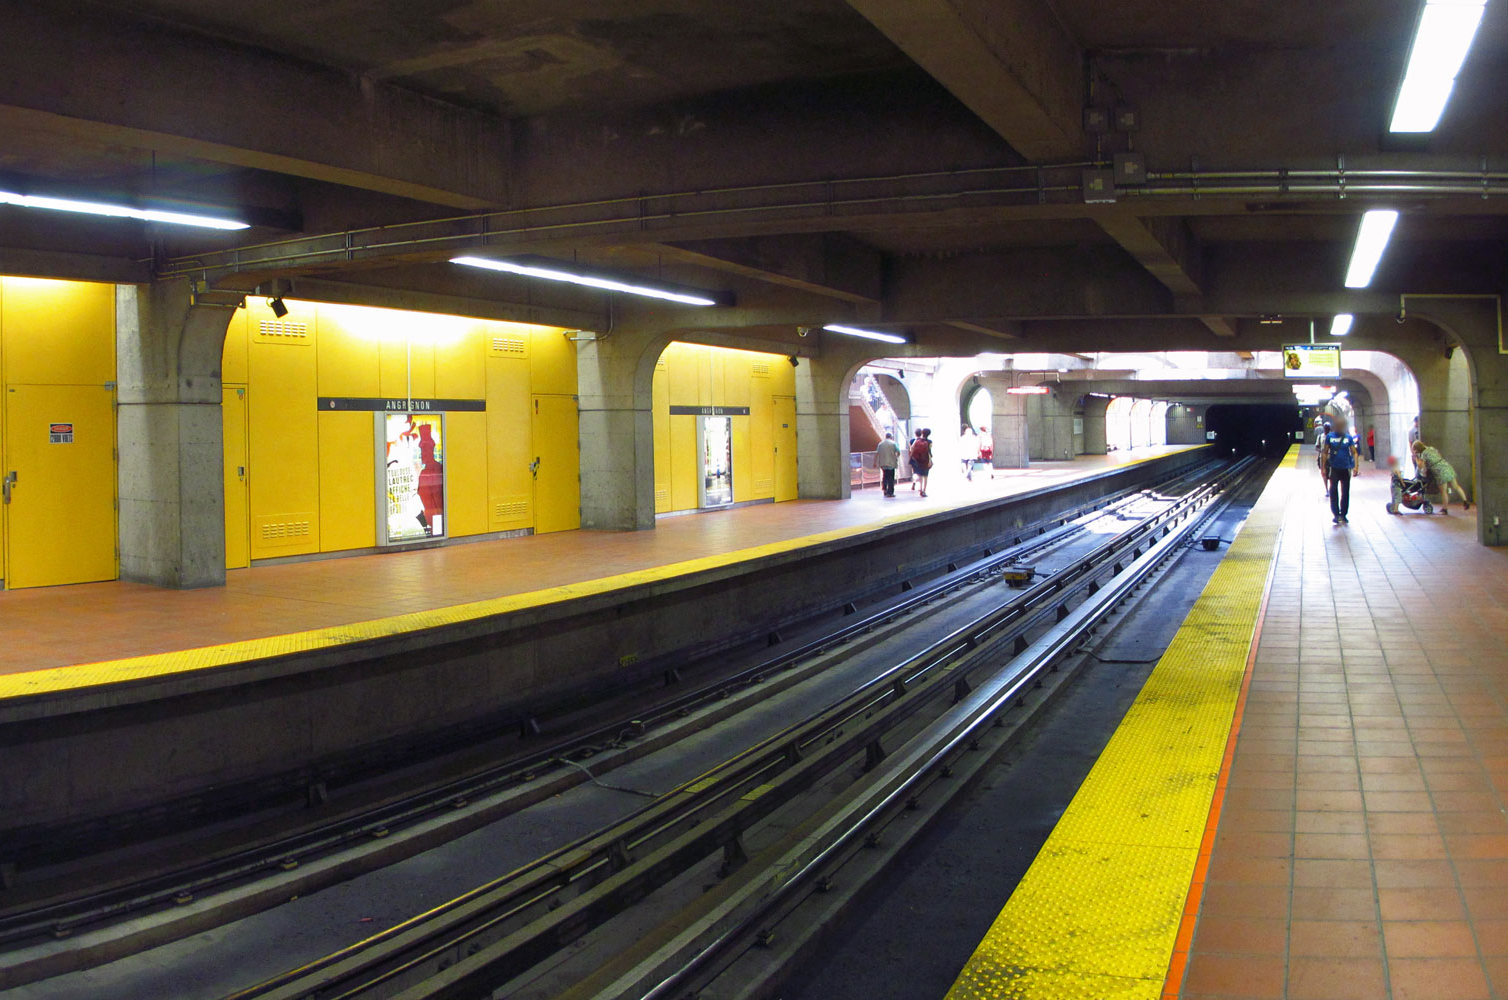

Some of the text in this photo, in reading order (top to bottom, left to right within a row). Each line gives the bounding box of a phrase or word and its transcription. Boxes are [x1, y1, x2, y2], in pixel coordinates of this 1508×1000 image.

[386, 400, 430, 410] ANGRGNON
[389, 475, 414, 486] LAUTREC
[389, 484, 411, 495] AFFICHE
